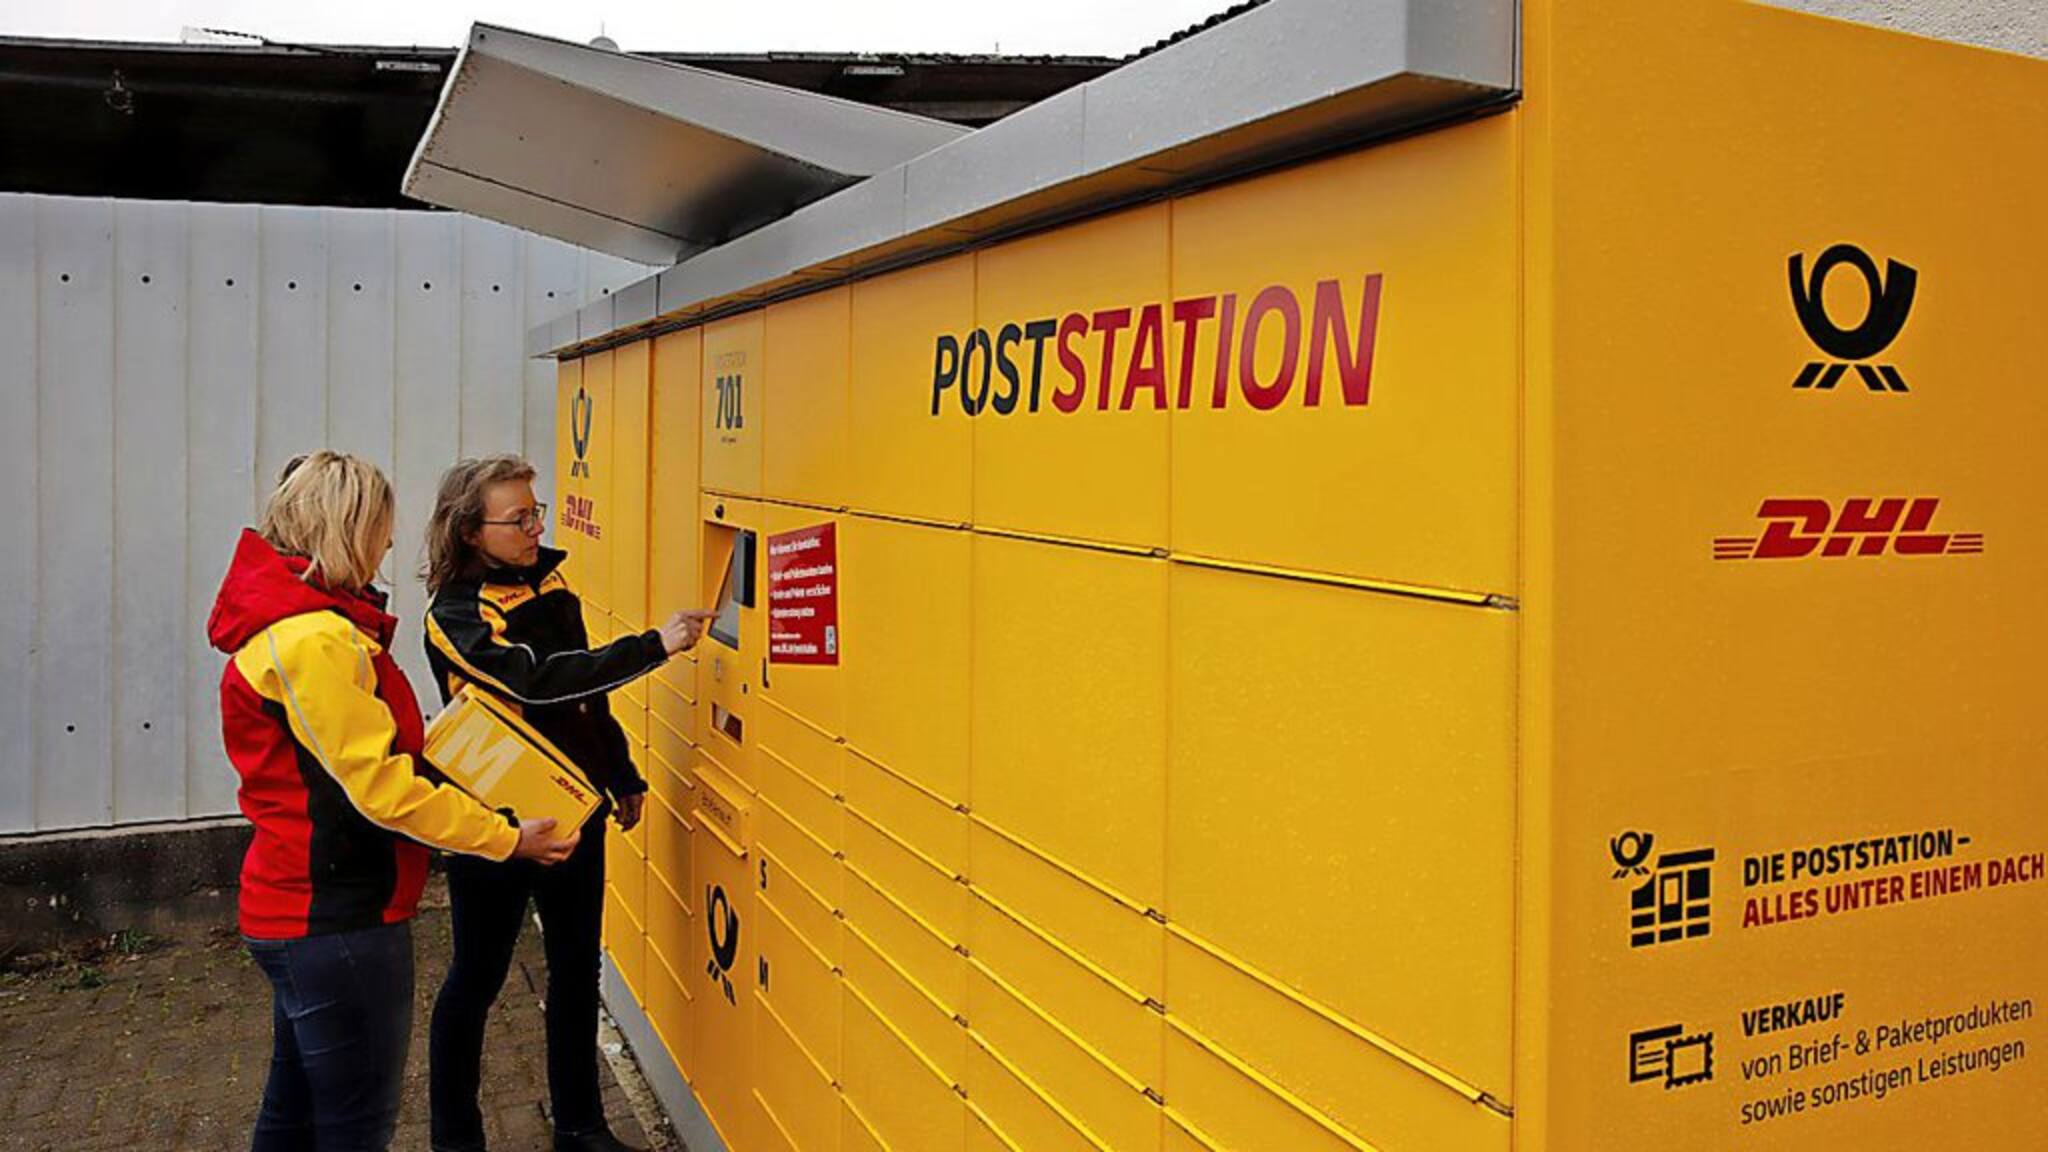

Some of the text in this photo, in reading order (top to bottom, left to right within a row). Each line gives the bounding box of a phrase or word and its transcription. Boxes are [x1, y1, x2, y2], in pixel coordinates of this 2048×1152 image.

[931, 273, 1383, 417] POSTSTATION
[716, 374, 743, 431] 701
[1745, 498, 1958, 559] DHL
[762, 657, 770, 689] L
[434, 703, 528, 797] M
[1742, 853, 2045, 928] ALLES UNTER EINEM DACH
[1743, 854, 1785, 887] DIE
[1791, 829, 1953, 880] POSTSTATION
[1741, 992, 1845, 1037] VERKAUF
[1741, 999, 2033, 1080] von Brief- & Paketprodukten
[1741, 1039, 2025, 1125] sowie sonstigen Leistungen
